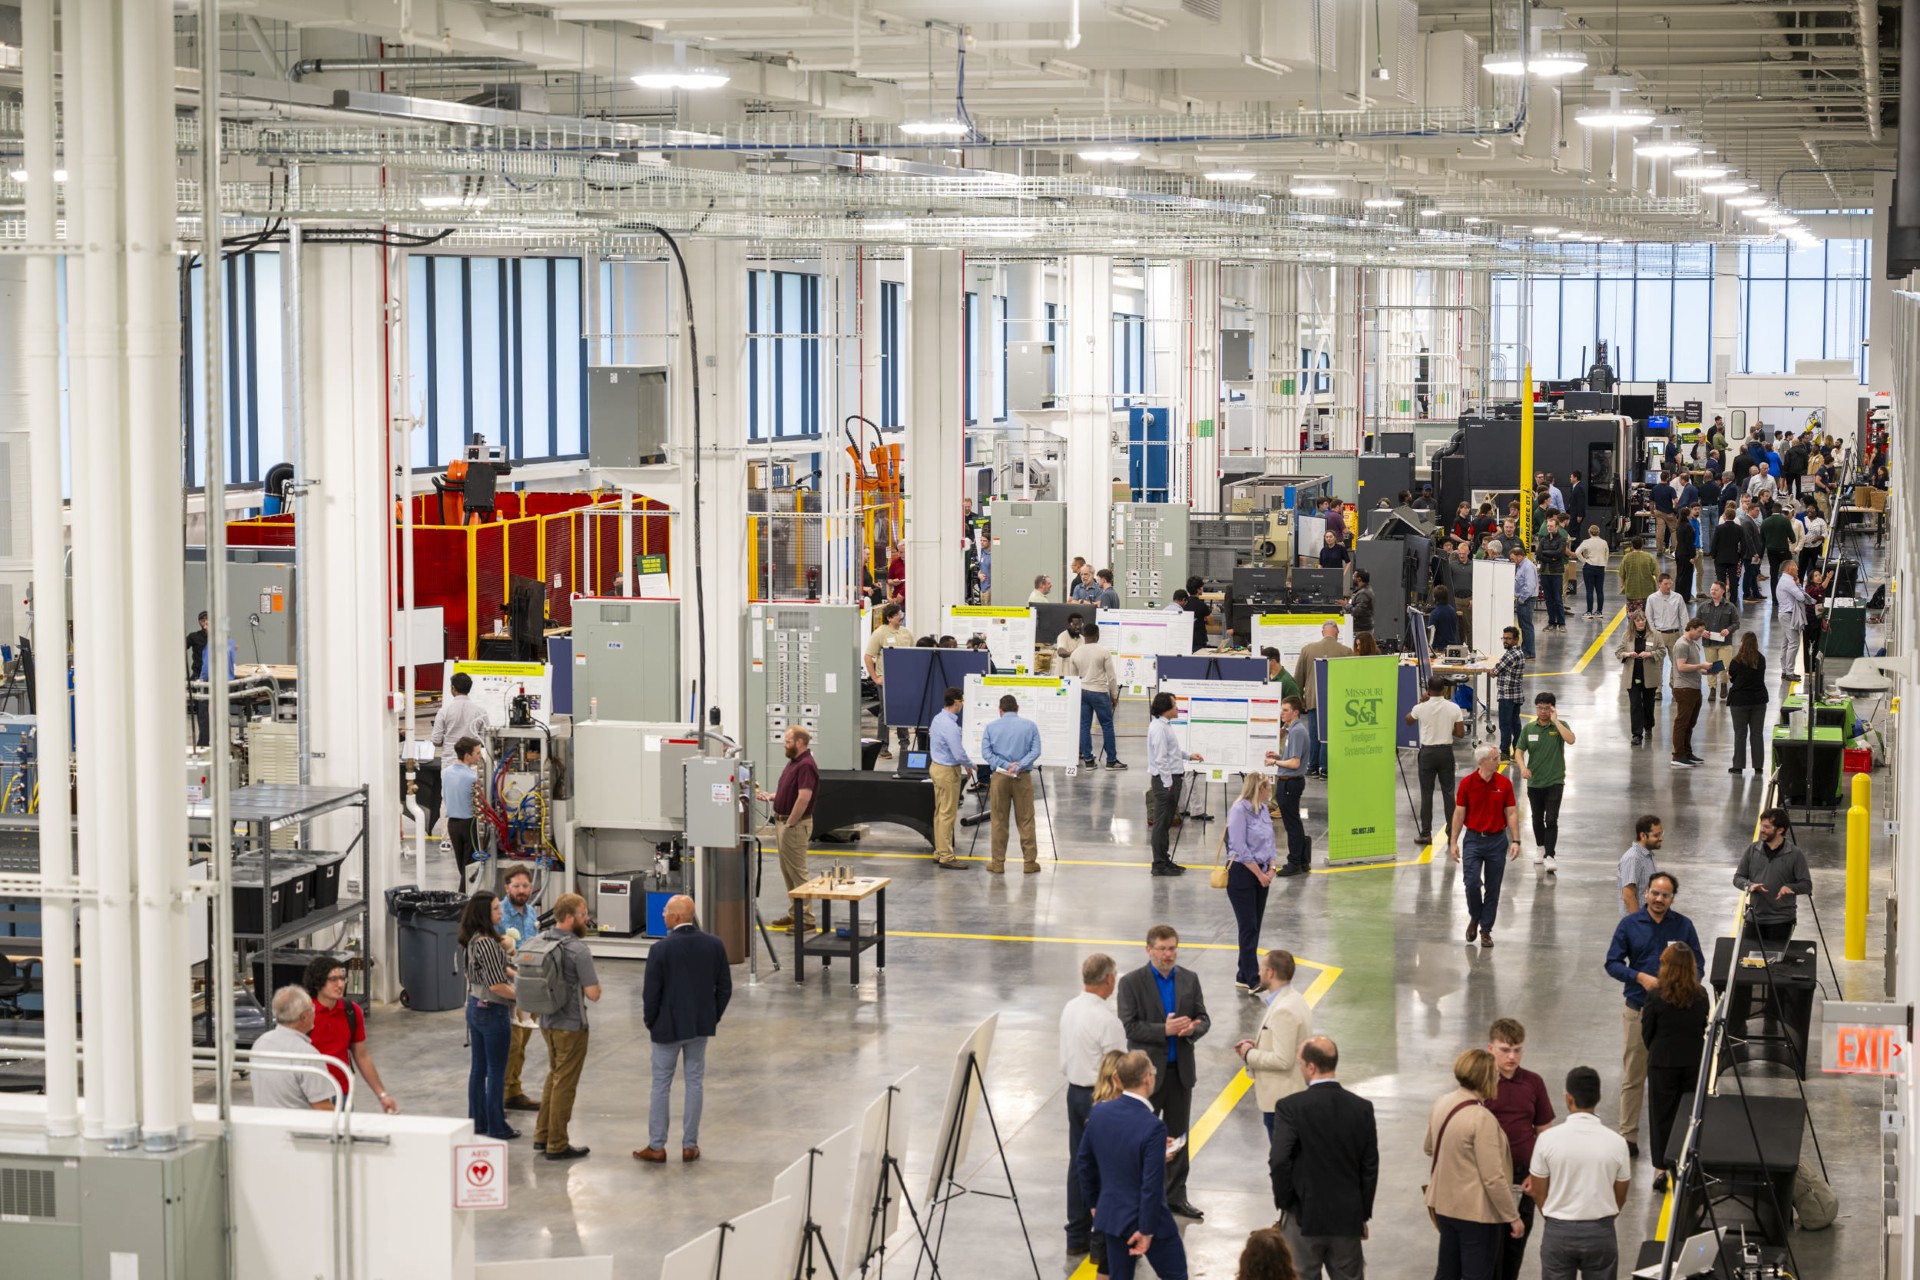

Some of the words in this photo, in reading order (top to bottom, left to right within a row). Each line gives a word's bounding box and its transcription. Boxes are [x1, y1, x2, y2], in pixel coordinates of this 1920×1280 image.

[1345, 688, 1383, 697] MISSOURI
[1345, 698, 1383, 727] S&T
[1837, 1027, 1895, 1070] EXIT
